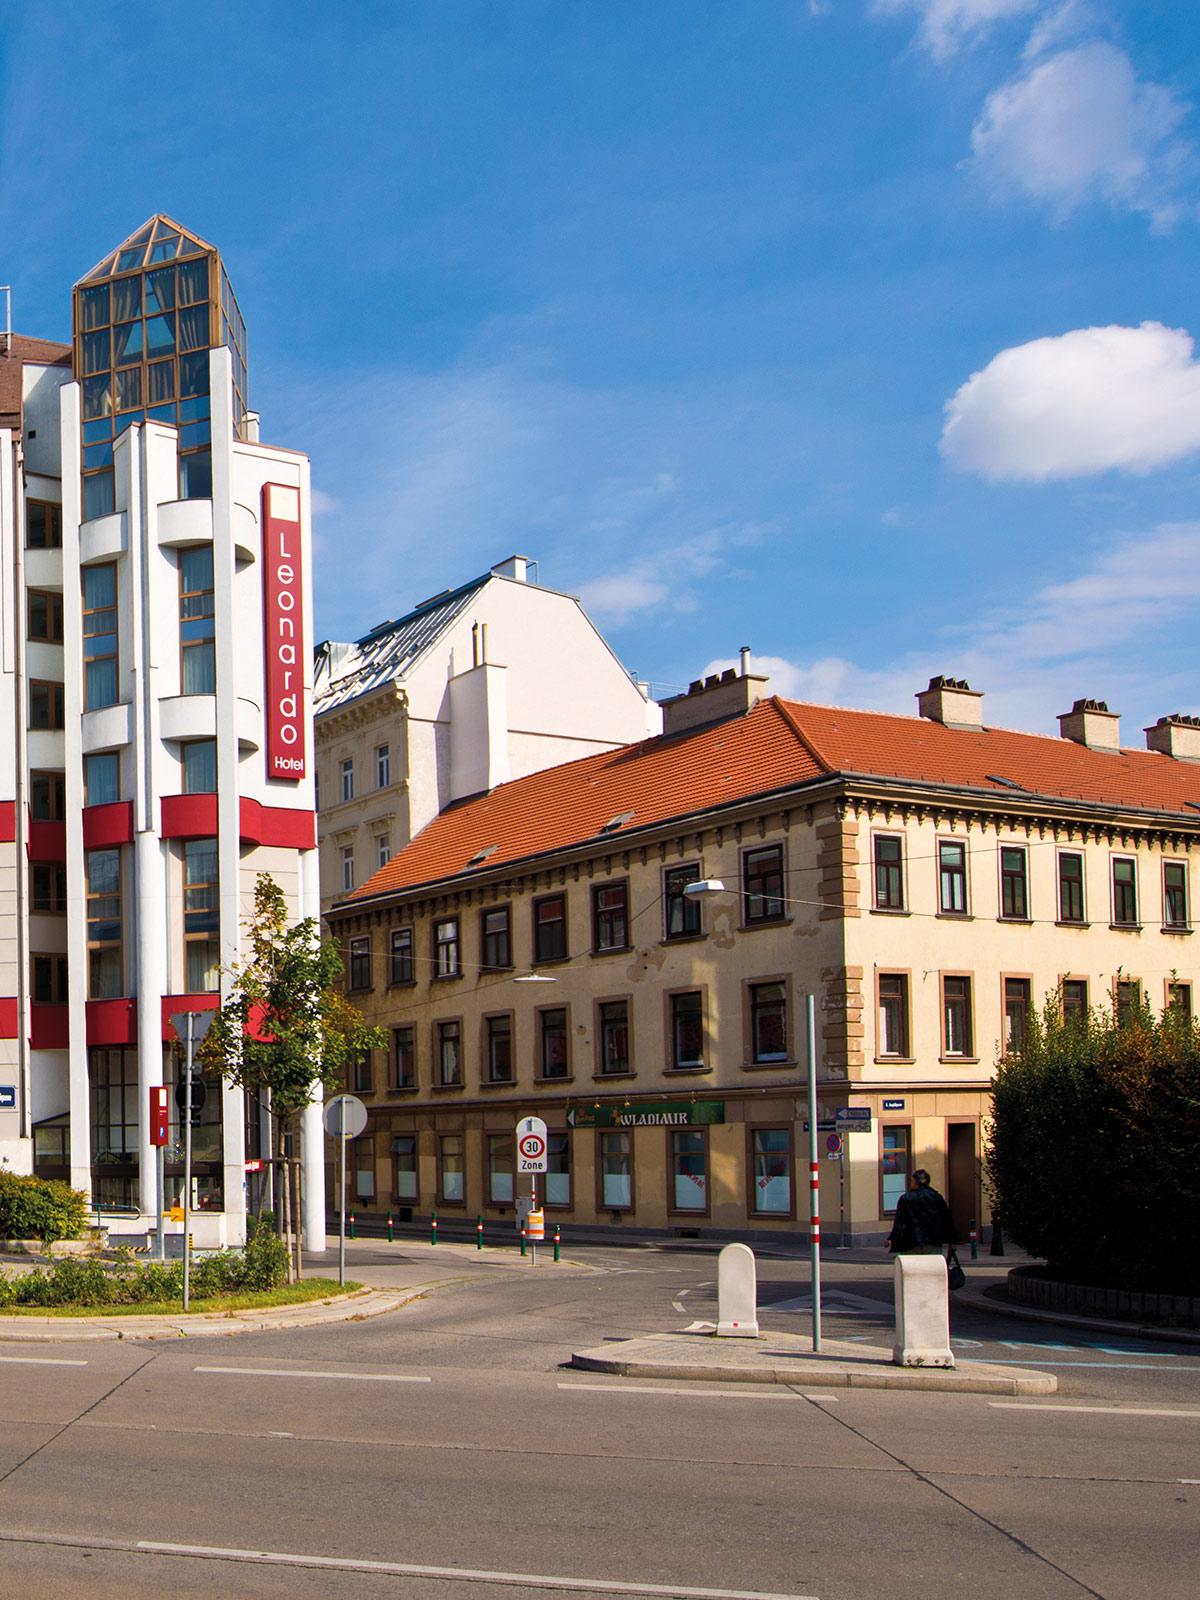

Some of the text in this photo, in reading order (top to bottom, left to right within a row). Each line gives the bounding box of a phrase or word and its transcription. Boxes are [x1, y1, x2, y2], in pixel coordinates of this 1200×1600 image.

[277, 532, 298, 745] Leonardo
[274, 756, 304, 771] Hotel
[620, 1112, 688, 1125] WLADIMIR
[526, 1141, 538, 1152] 30
[522, 1160, 543, 1169] Zone
